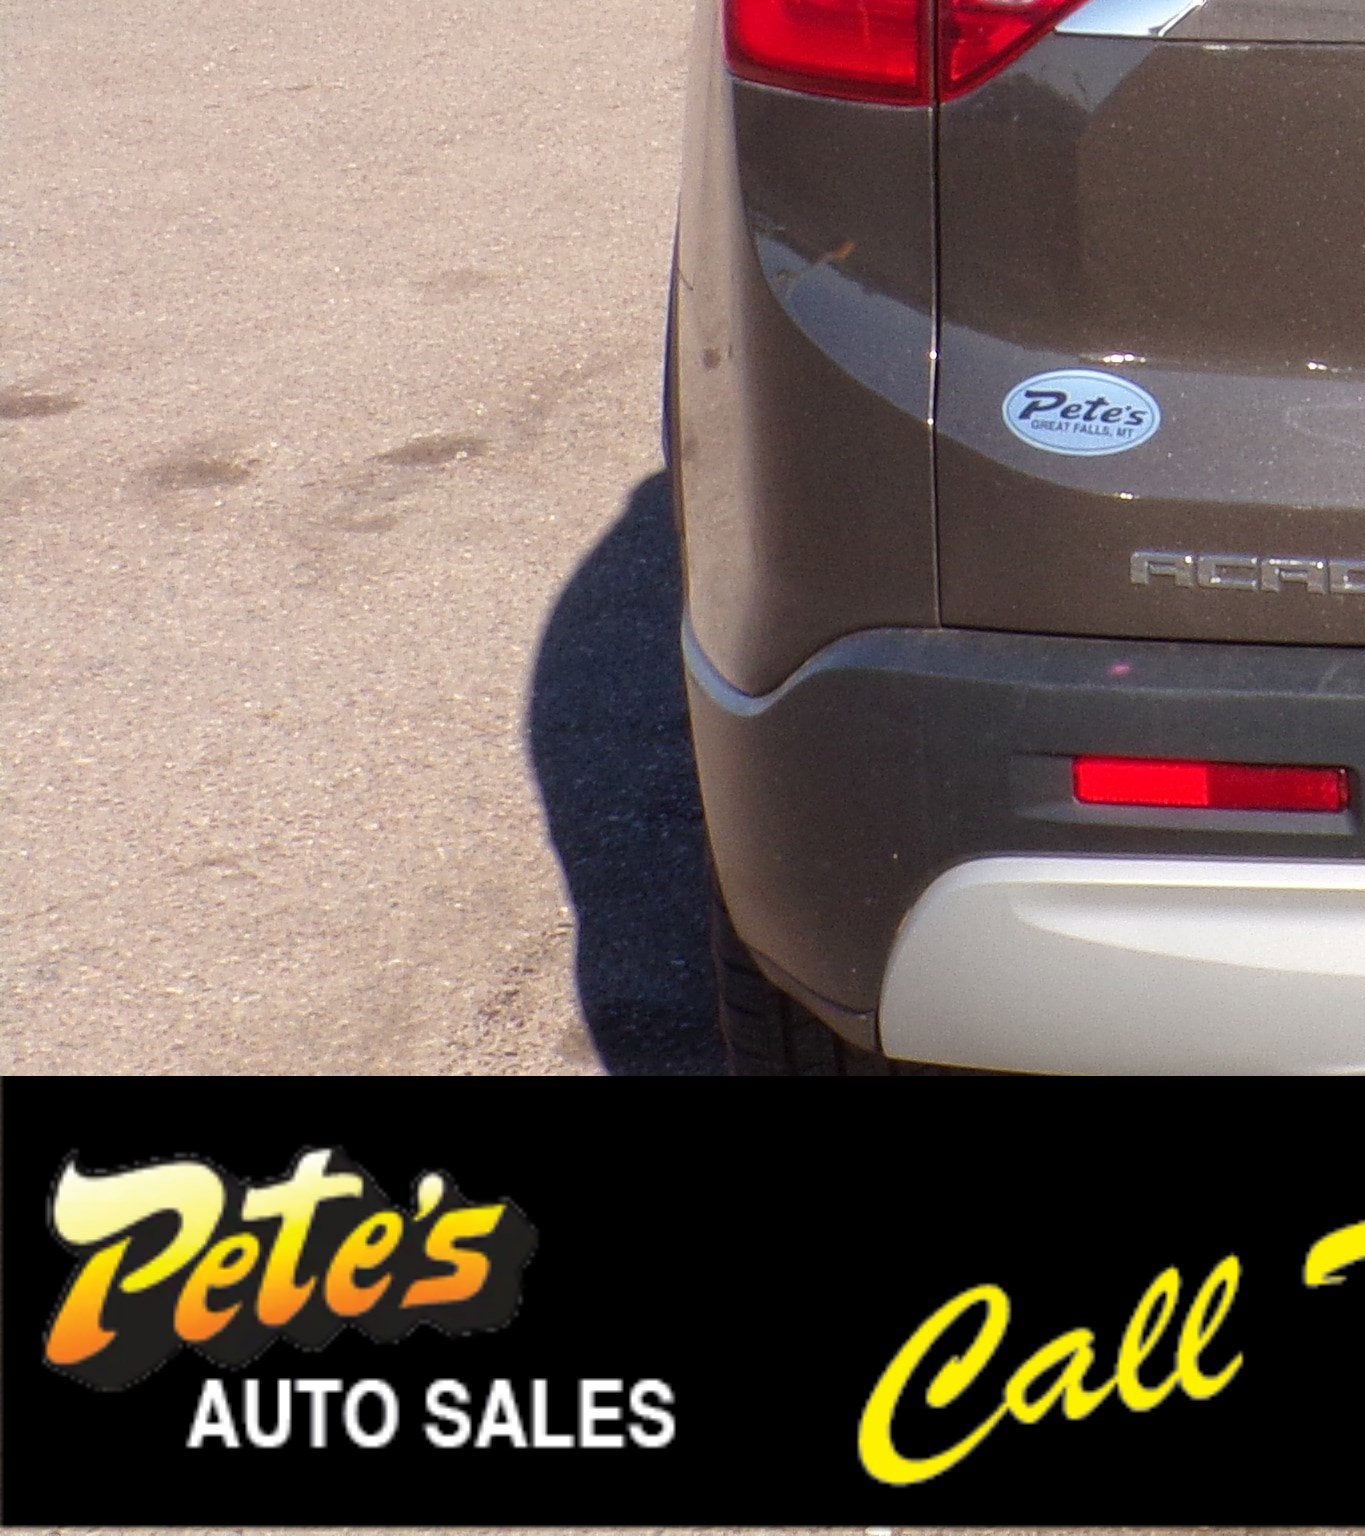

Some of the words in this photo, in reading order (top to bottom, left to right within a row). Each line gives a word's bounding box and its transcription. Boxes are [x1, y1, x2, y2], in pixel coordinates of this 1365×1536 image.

[1018, 390, 1148, 426] Pete's
[1031, 419, 1069, 432] GREAT
[1116, 428, 1135, 439] MT
